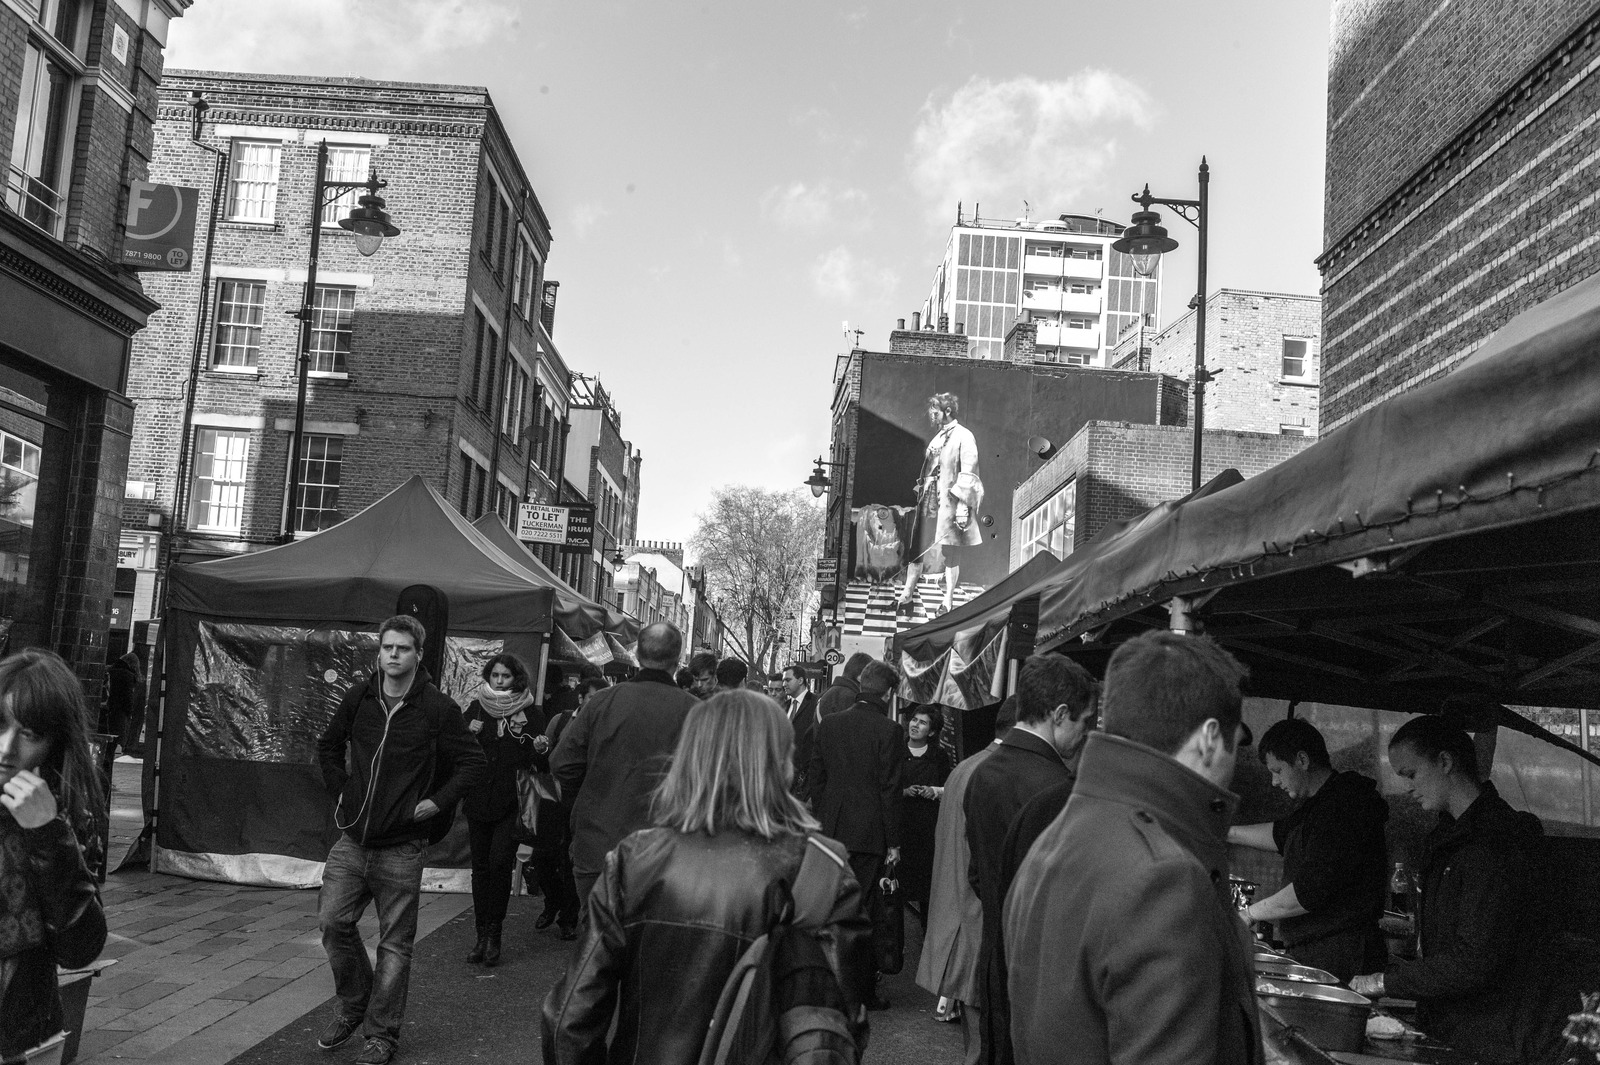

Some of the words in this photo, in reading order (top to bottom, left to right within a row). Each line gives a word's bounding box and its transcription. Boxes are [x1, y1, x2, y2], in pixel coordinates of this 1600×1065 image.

[143, 252, 162, 260] 9800
[170, 257, 184, 265] LET
[526, 511, 539, 520] TO
[542, 512, 559, 522] LET
[522, 520, 563, 529] TUCKERMAN
[827, 654, 838, 662] 20
